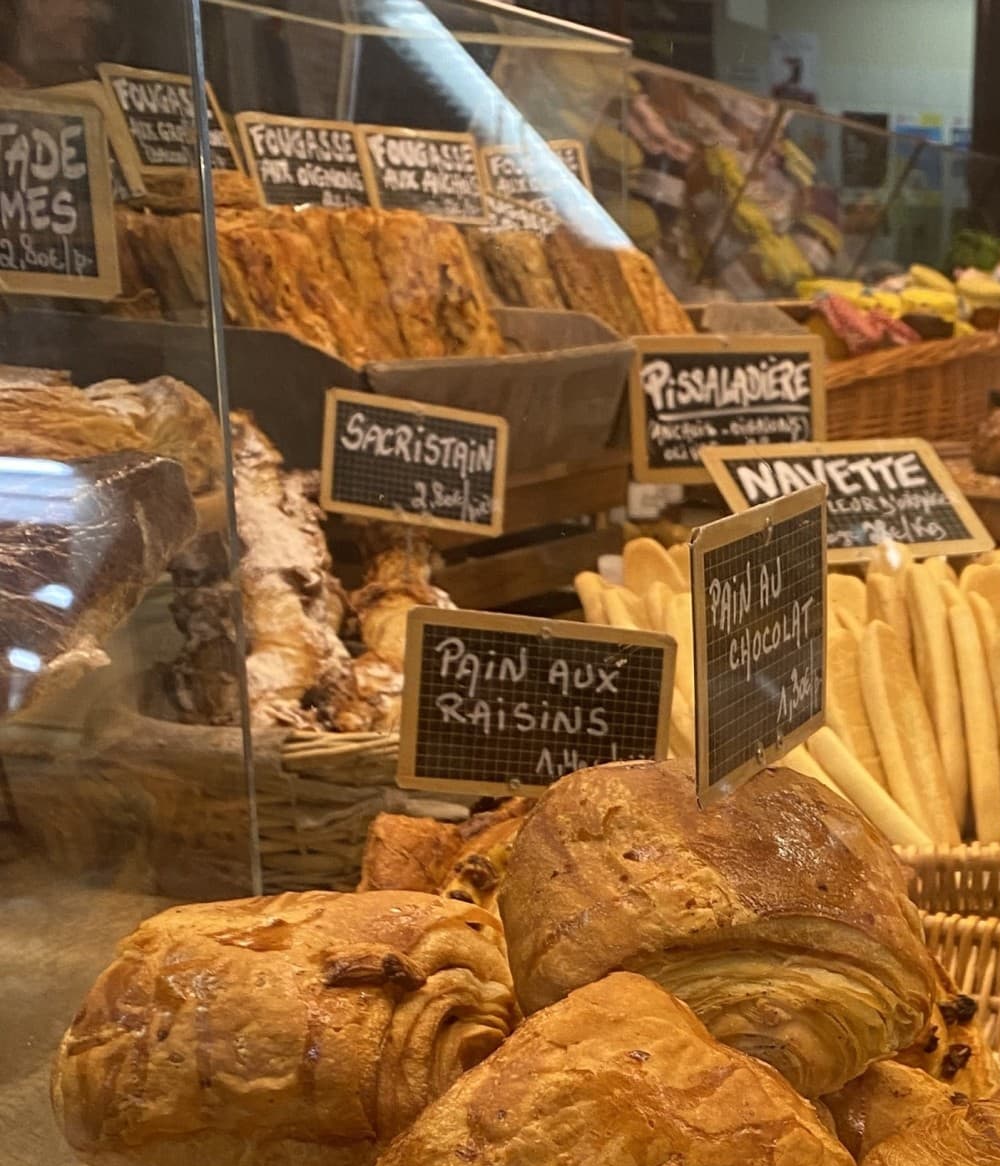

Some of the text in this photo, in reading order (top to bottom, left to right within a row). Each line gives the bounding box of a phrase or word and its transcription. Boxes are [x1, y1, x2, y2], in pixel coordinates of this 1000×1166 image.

[249, 124, 357, 163] FOUGASSE
[367, 133, 475, 172] FOUGASSE
[736, 452, 927, 501] NAVETTE
[759, 557, 782, 609] AU
[729, 597, 814, 682] CHOCOLAT
[549, 658, 620, 697] AUX
